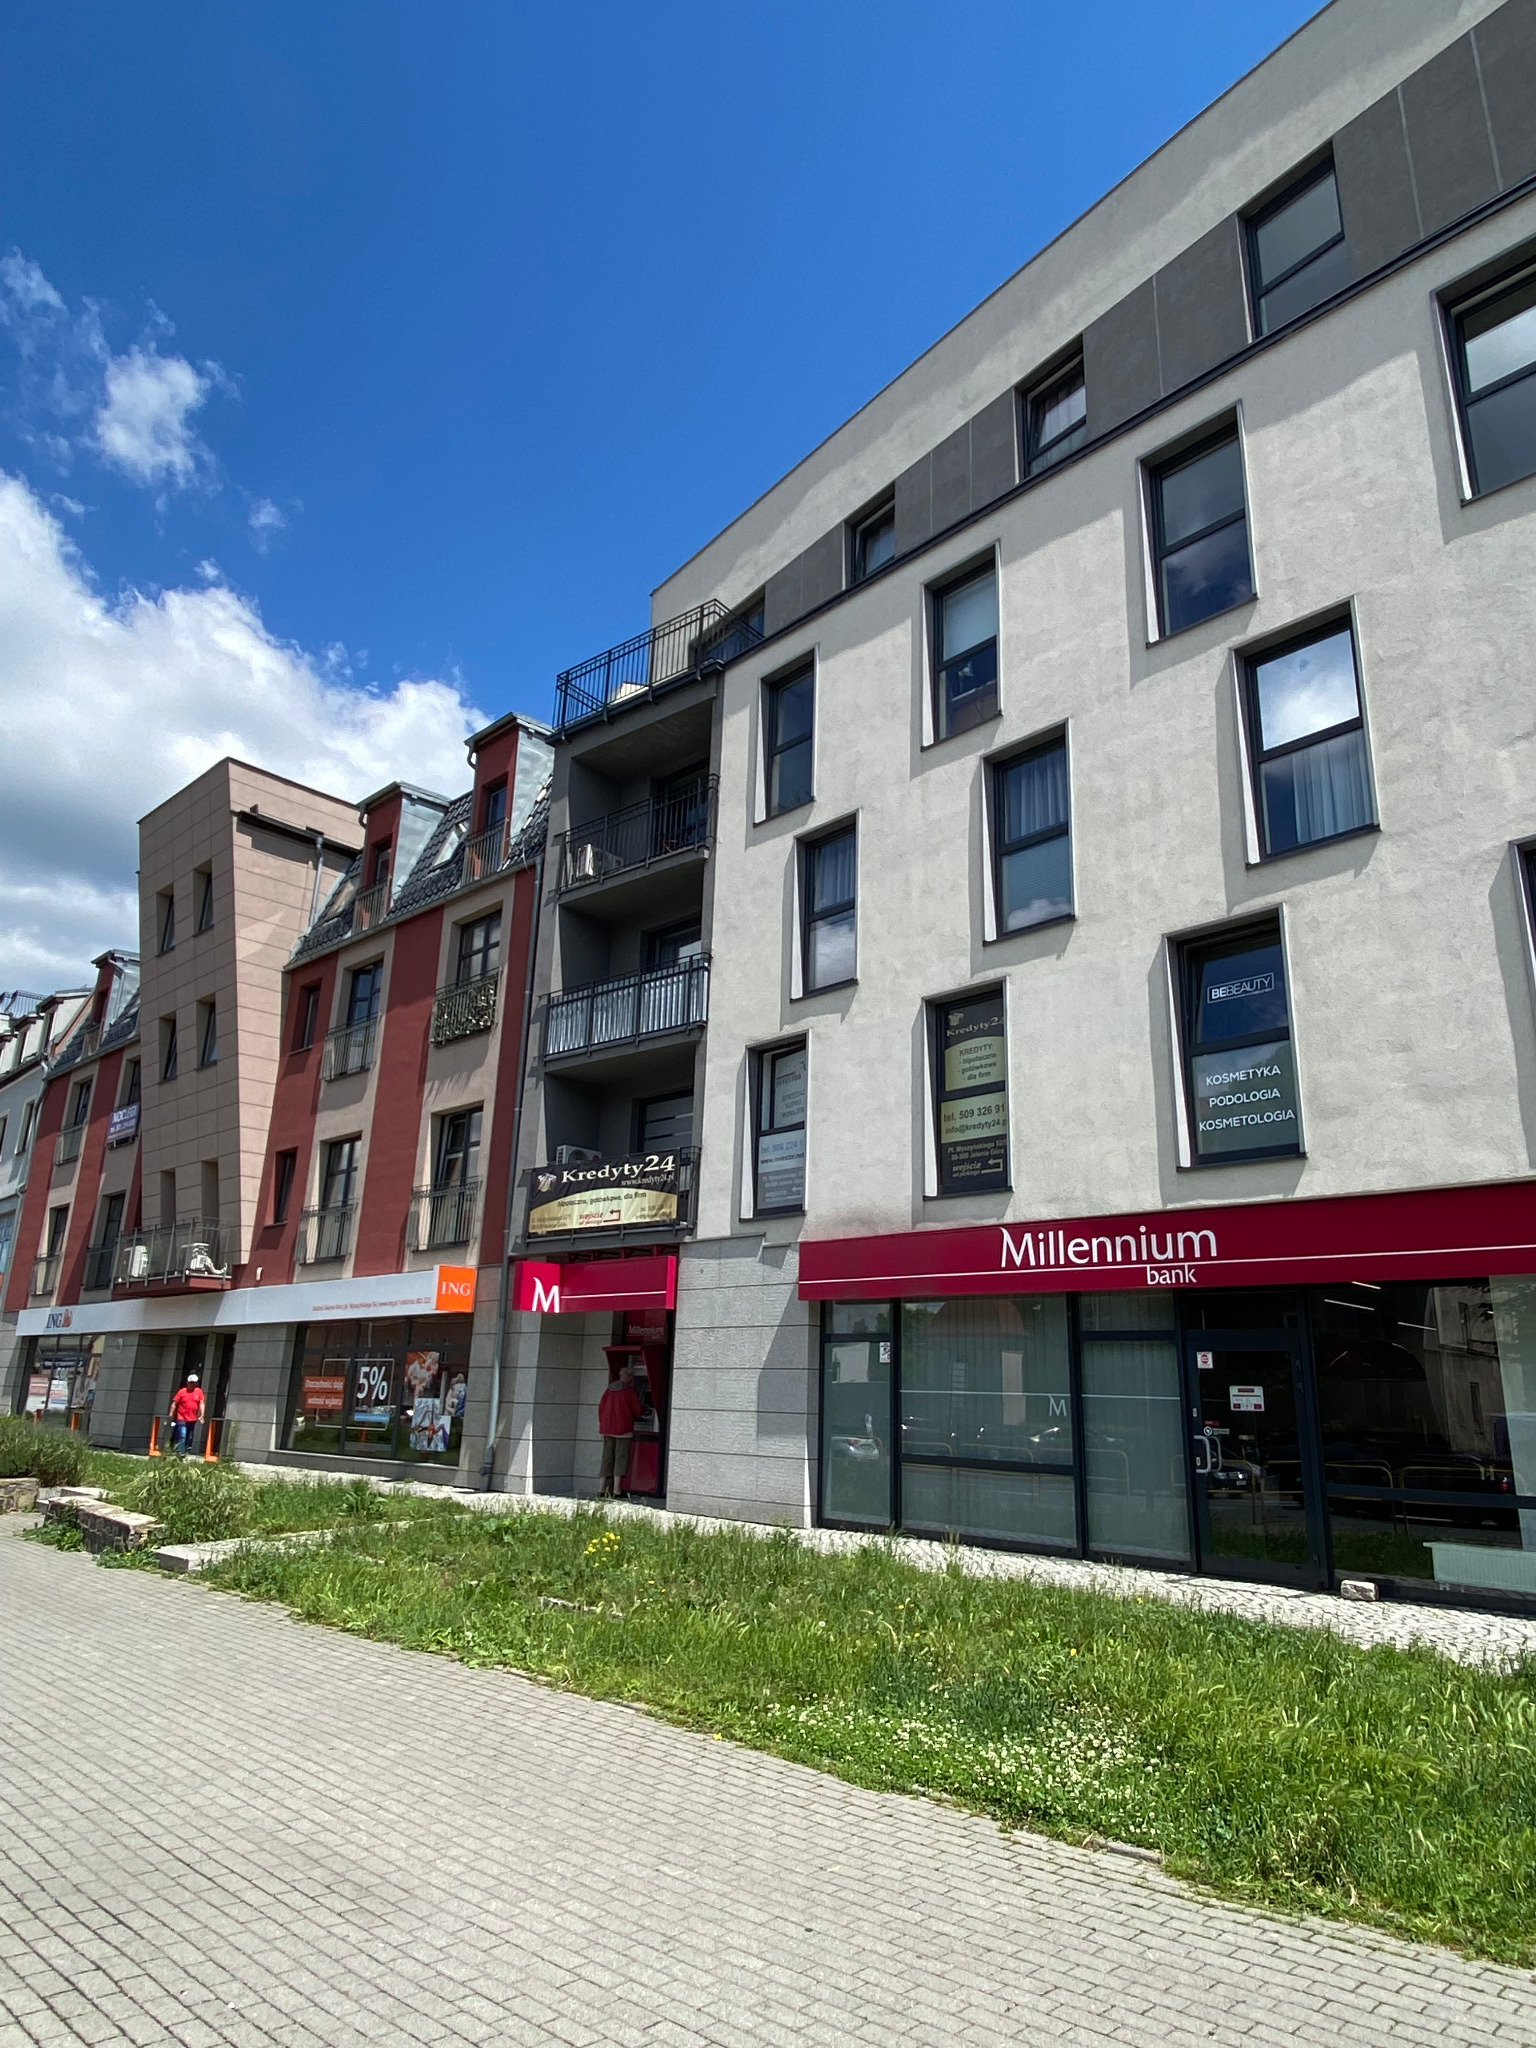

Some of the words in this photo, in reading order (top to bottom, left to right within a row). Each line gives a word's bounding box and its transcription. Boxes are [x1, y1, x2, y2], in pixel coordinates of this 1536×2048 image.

[1211, 976, 1271, 999] BEBEAUTY
[978, 1071, 991, 1079] firm
[1206, 1065, 1281, 1086] KOSMETYKA
[1209, 1088, 1281, 1108] PODOLOGIA
[943, 1112, 957, 1122] tel.
[959, 1109, 974, 1119] 509
[977, 1105, 992, 1117] 326
[1199, 1109, 1295, 1131] KOSMETOLOGIA
[561, 1155, 676, 1184] Kredyty24
[999, 1225, 1218, 1268] Millennium
[1147, 1264, 1197, 1285] bank
[441, 1281, 471, 1296] ING
[532, 1277, 560, 1313] M
[46, 1313, 63, 1329] ING
[629, 1325, 665, 1335] Millennium
[357, 1366, 388, 1400] 5%
[1049, 1394, 1067, 1417] M
